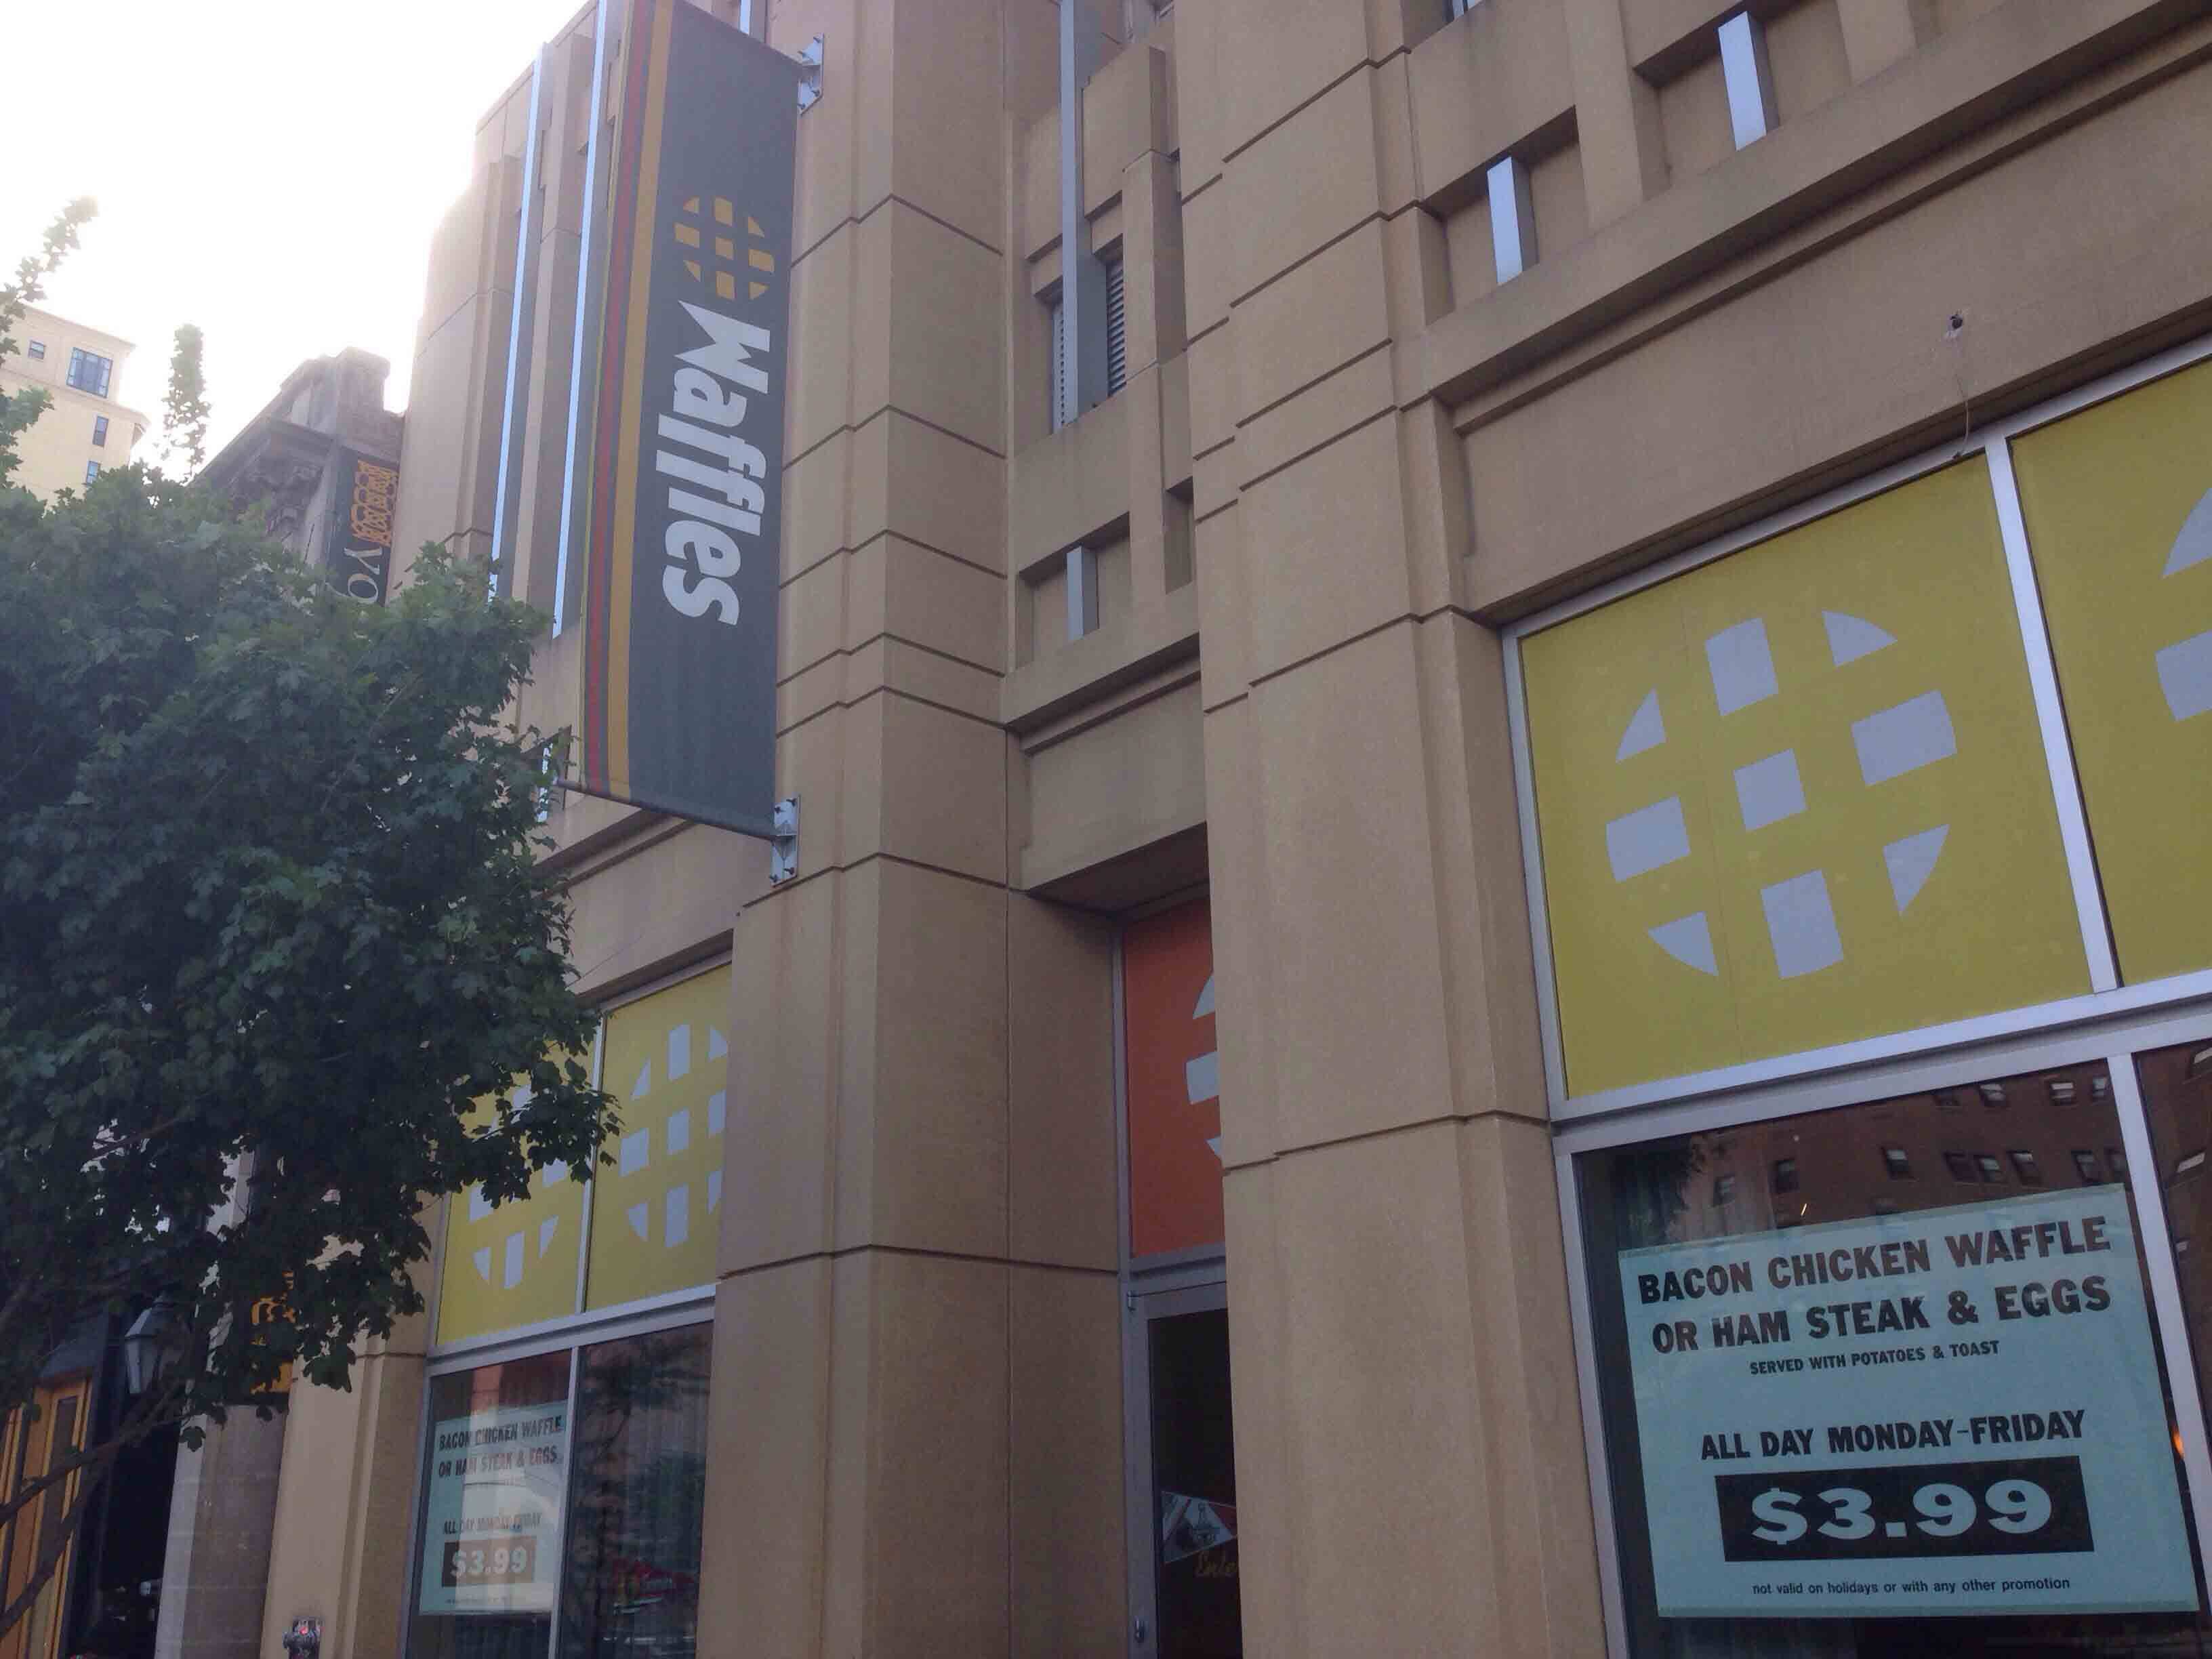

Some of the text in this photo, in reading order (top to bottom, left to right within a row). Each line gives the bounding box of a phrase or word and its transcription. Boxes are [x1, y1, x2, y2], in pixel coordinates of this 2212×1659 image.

[655, 300, 771, 626] Waffles
[1637, 1216, 2111, 1304] BACON CHICKEN WAFFLE
[1652, 1275, 2111, 1354] OR HAM STEAK & EGGS
[1749, 1340, 2000, 1375] SERVED WITH POTATOES & TOAST
[438, 1430, 470, 1452] BACON
[1701, 1433, 1751, 1460] ALL
[1759, 1428, 1814, 1457] DAY
[438, 1460, 452, 1478] OR
[1750, 1479, 2053, 1546] $3.99
[450, 1544, 528, 1579] $3.99
[1752, 1578, 2071, 1596] not valid on holidays or with any other promotion
